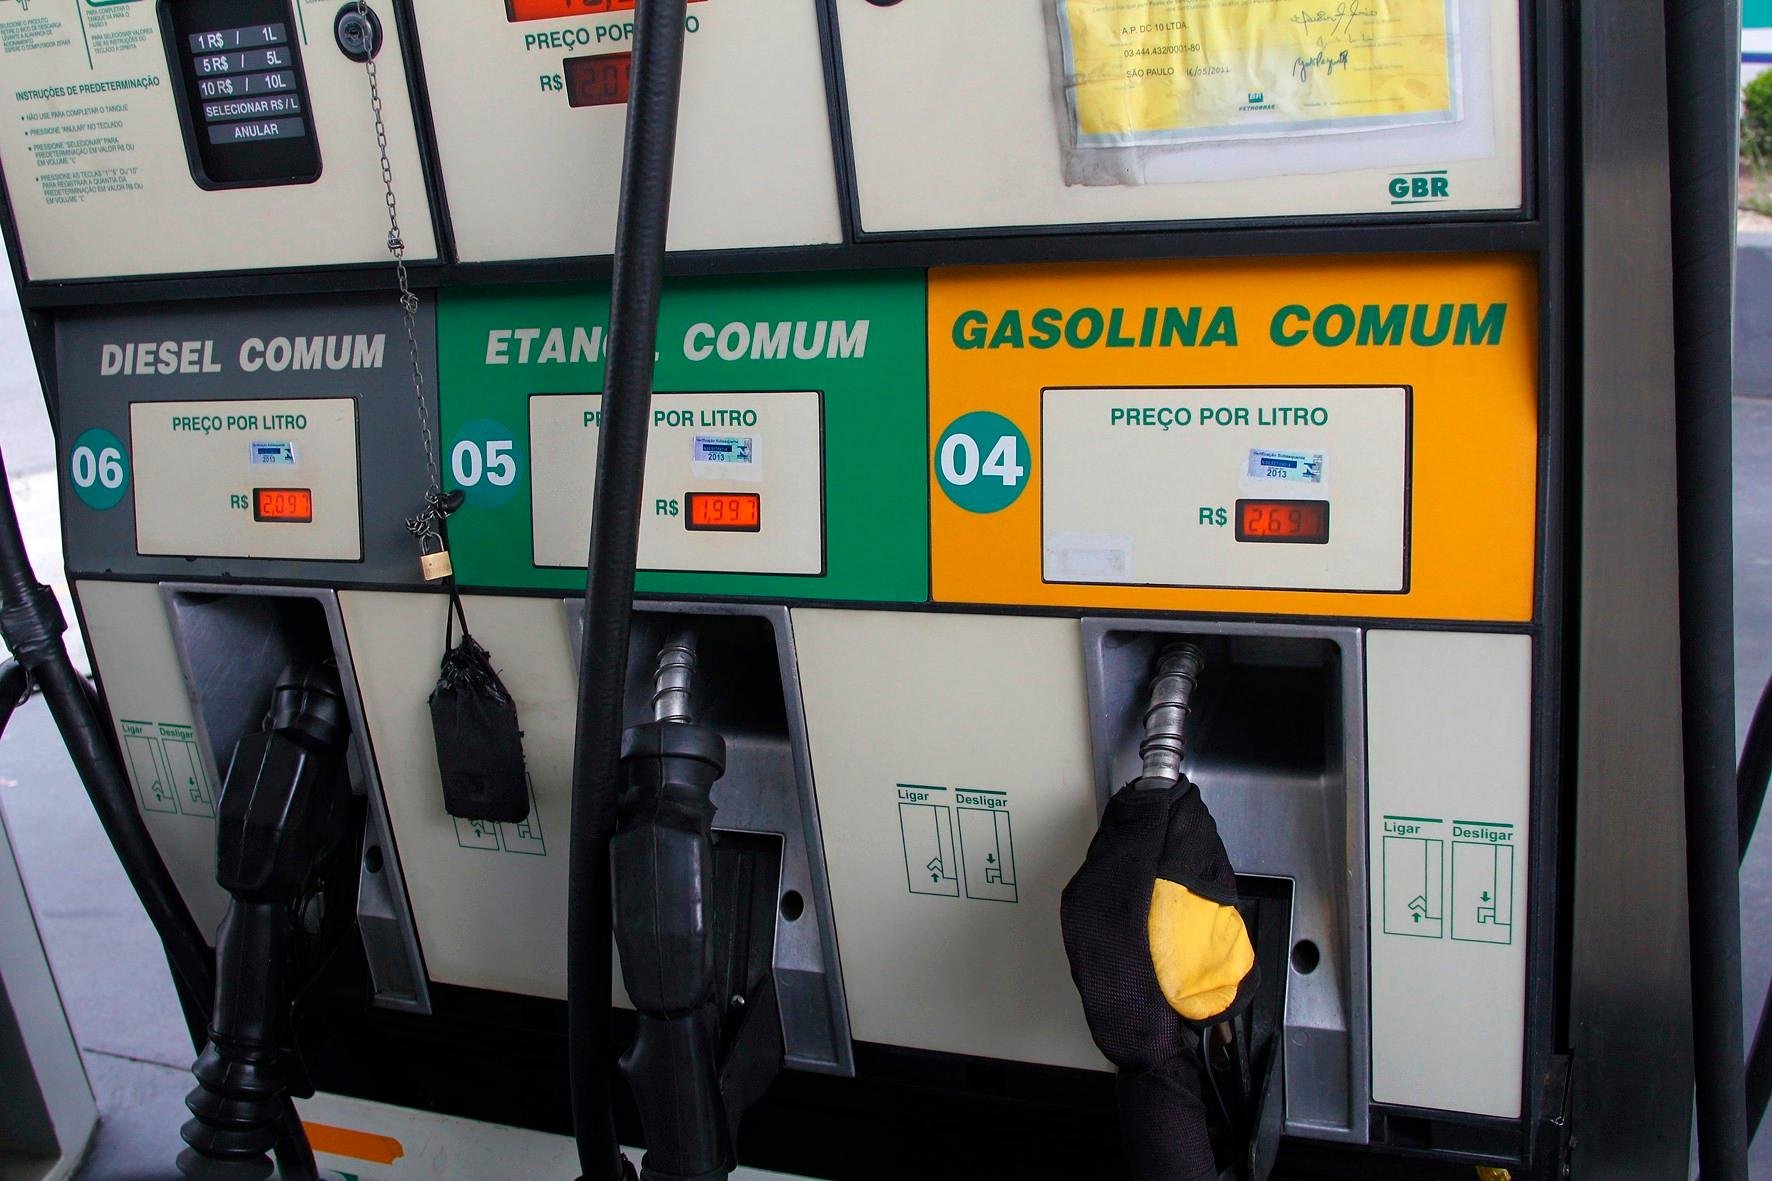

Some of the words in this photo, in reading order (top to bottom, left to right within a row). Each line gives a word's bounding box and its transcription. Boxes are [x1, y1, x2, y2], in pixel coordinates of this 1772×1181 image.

[524, 28, 590, 51] PREÇO
[596, 23, 634, 43] POR
[1155, 23, 1164, 32] 10
[198, 36, 205, 48] 1
[208, 32, 224, 48] R$
[262, 27, 278, 41] 1L
[203, 59, 211, 72] 5
[213, 56, 228, 72] R$
[266, 51, 282, 65] 5L
[1126, 67, 1144, 78] SÃO
[1146, 66, 1174, 76] PAULO
[16, 86, 66, 101] INSTRUÇÕES
[68, 86, 78, 96] DE
[79, 75, 160, 94] PREDETERMINAÇÃO
[202, 82, 215, 96] 10
[217, 79, 234, 95] R$
[264, 75, 286, 89] 10L
[540, 74, 563, 92] R$
[26, 112, 38, 120] NÃO
[51, 110, 65, 118] PARA
[66, 106, 99, 118] COMPLETAR
[105, 104, 128, 113] TANQUE
[206, 101, 268, 118] SELECIONAR
[271, 100, 284, 111] R$
[30, 126, 61, 136] PRESSIONE
[88, 122, 96, 130] NO
[96, 120, 122, 130] TECLADO
[234, 124, 278, 138] ANULAR
[34, 142, 64, 151] PRESSIONE
[36, 148, 88, 159] PREDETERMINAÇÃO
[99, 144, 117, 153] VALOR
[46, 157, 69, 166] VOLUME
[40, 172, 72, 182] PRESSIONE
[1388, 177, 1450, 198] GBR
[950, 306, 1238, 350] GASOLINA
[1268, 302, 1508, 348] COMUM
[484, 326, 660, 366] ETAN
[682, 320, 870, 361] COMUM
[100, 340, 222, 376] DIESEL
[238, 334, 386, 372] COMUM
[172, 416, 222, 435] PREÇO
[227, 416, 257, 430] POR
[263, 414, 308, 430] LITRO
[654, 410, 694, 427] POR
[700, 410, 758, 428] LITRO
[1110, 408, 1192, 432] PREÇO
[1199, 407, 1251, 427] POR
[1257, 406, 1329, 427] LITRO
[72, 446, 124, 488] 06
[452, 440, 517, 488] 05
[939, 432, 1024, 487] 04
[1267, 470, 1287, 478] 2013
[230, 494, 249, 510] R$
[655, 500, 679, 518] R$
[704, 500, 756, 523] 1,997
[1199, 506, 1228, 530] R$
[122, 724, 142, 735] Ligar
[160, 728, 193, 739] Desligar
[898, 789, 928, 802] Ligar
[956, 794, 1008, 808] Desligar
[1384, 822, 1421, 836] Ligar
[1452, 826, 1514, 842] Desligar
